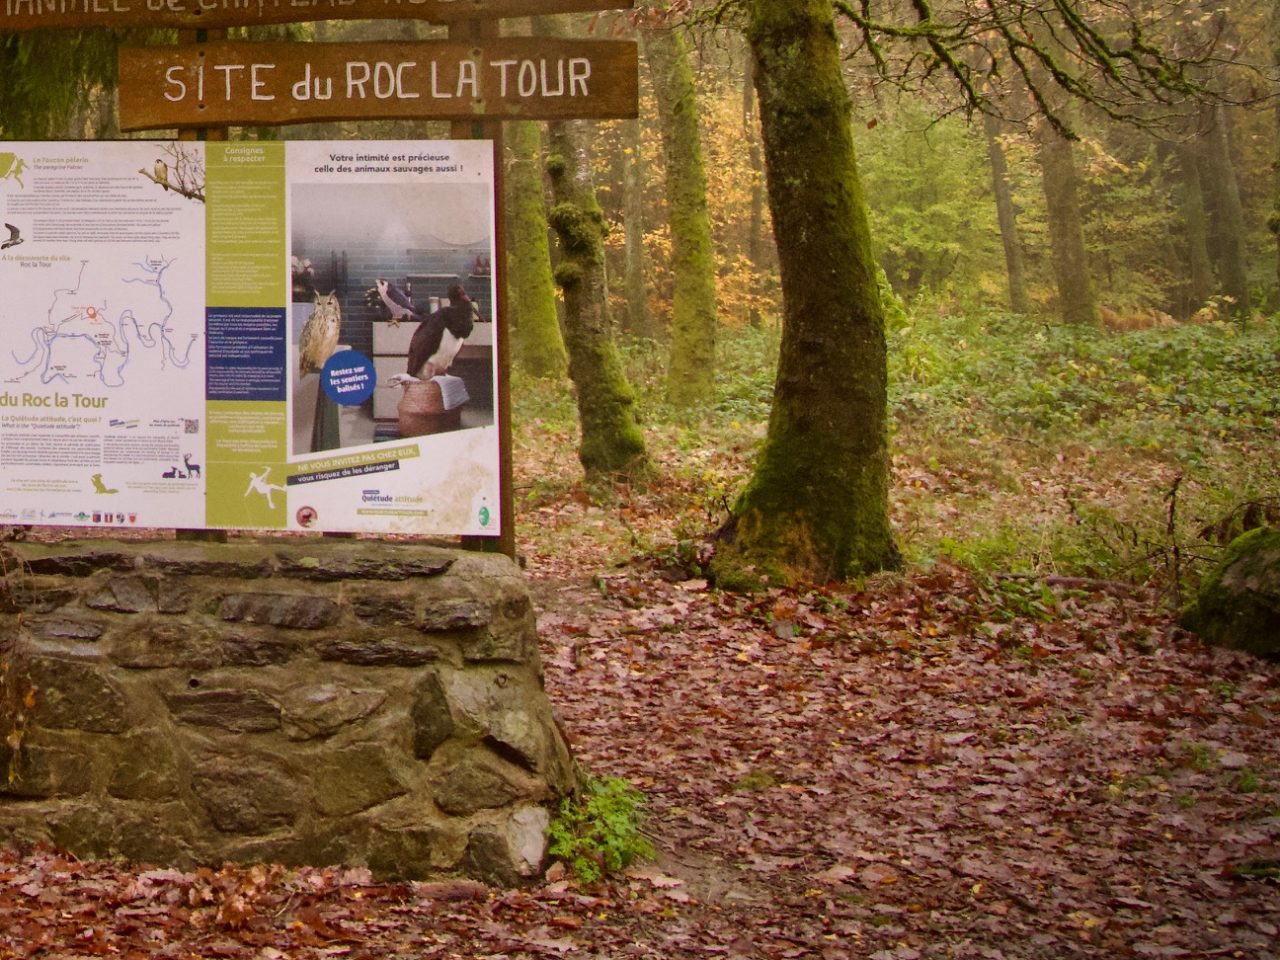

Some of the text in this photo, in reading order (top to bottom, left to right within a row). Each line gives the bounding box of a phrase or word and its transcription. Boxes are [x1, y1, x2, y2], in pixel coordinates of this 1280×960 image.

[163, 57, 591, 101] SITE du ROC LA TOUR
[224, 146, 264, 156] Consignes
[330, 154, 354, 162] Votre
[356, 154, 390, 162] intimité
[408, 154, 450, 163] précieuse
[315, 165, 334, 173] celle
[337, 165, 352, 173] des
[355, 165, 390, 173] animaux
[393, 166, 433, 174] sauvages
[436, 165, 457, 173] aussi
[331, 368, 353, 377] Restez
[341, 375, 369, 384] sentiers
[0, 392, 18, 407] du
[22, 393, 51, 408] Roc
[55, 393, 69, 408] la
[72, 394, 109, 409] Tour
[310, 461, 332, 470] VOUS
[332, 458, 361, 467] INVITEZ
[362, 455, 376, 463] PAS
[377, 451, 397, 460] CHEZ
[315, 471, 341, 481] risquez
[342, 469, 352, 477] de
[352, 467, 363, 475] les
[362, 495, 393, 503] Quiétude
